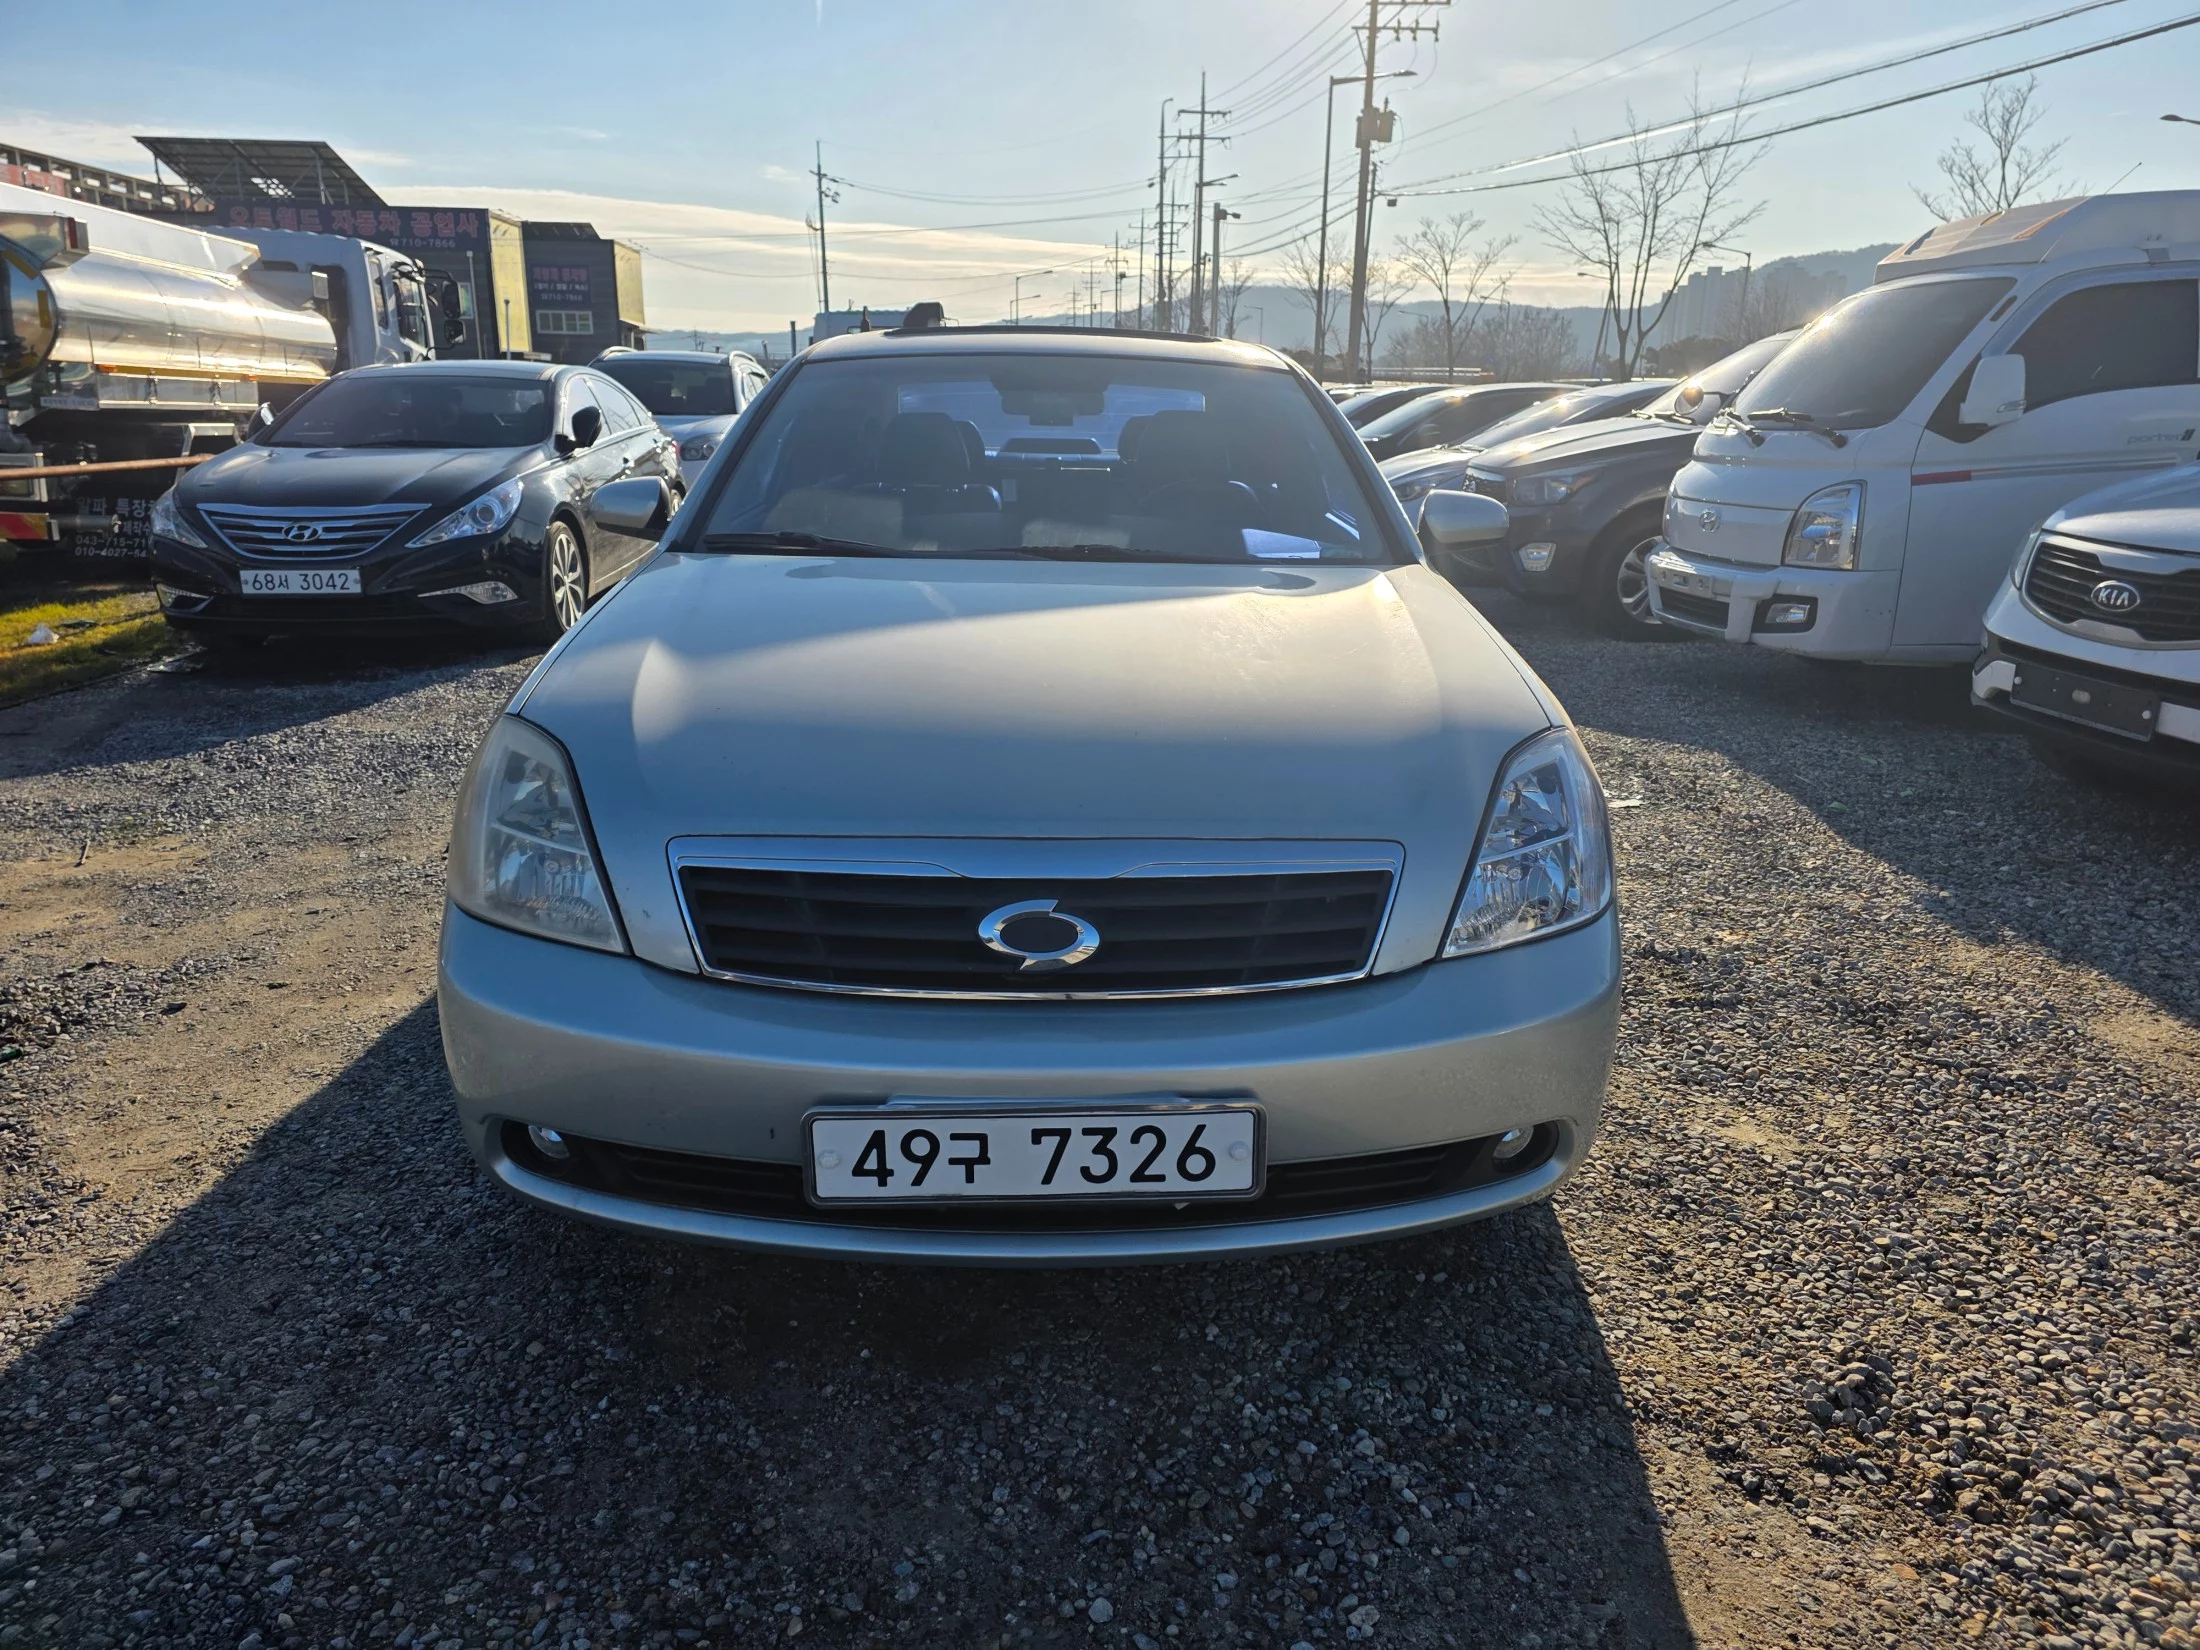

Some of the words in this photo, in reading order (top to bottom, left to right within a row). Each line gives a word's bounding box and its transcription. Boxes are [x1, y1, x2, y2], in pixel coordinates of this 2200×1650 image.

[332, 209, 400, 236] 자동차
[411, 211, 479, 238] 공업사
[401, 239, 456, 248] 710-7866
[76, 535, 146, 548] 043-715-71
[75, 547, 147, 557] 010-4027-54
[252, 574, 290, 591] 68서
[298, 573, 350, 590] 3042
[2098, 588, 2130, 607] KIA
[852, 1129, 990, 1187] 49구
[1031, 1124, 1216, 1185] 7326
